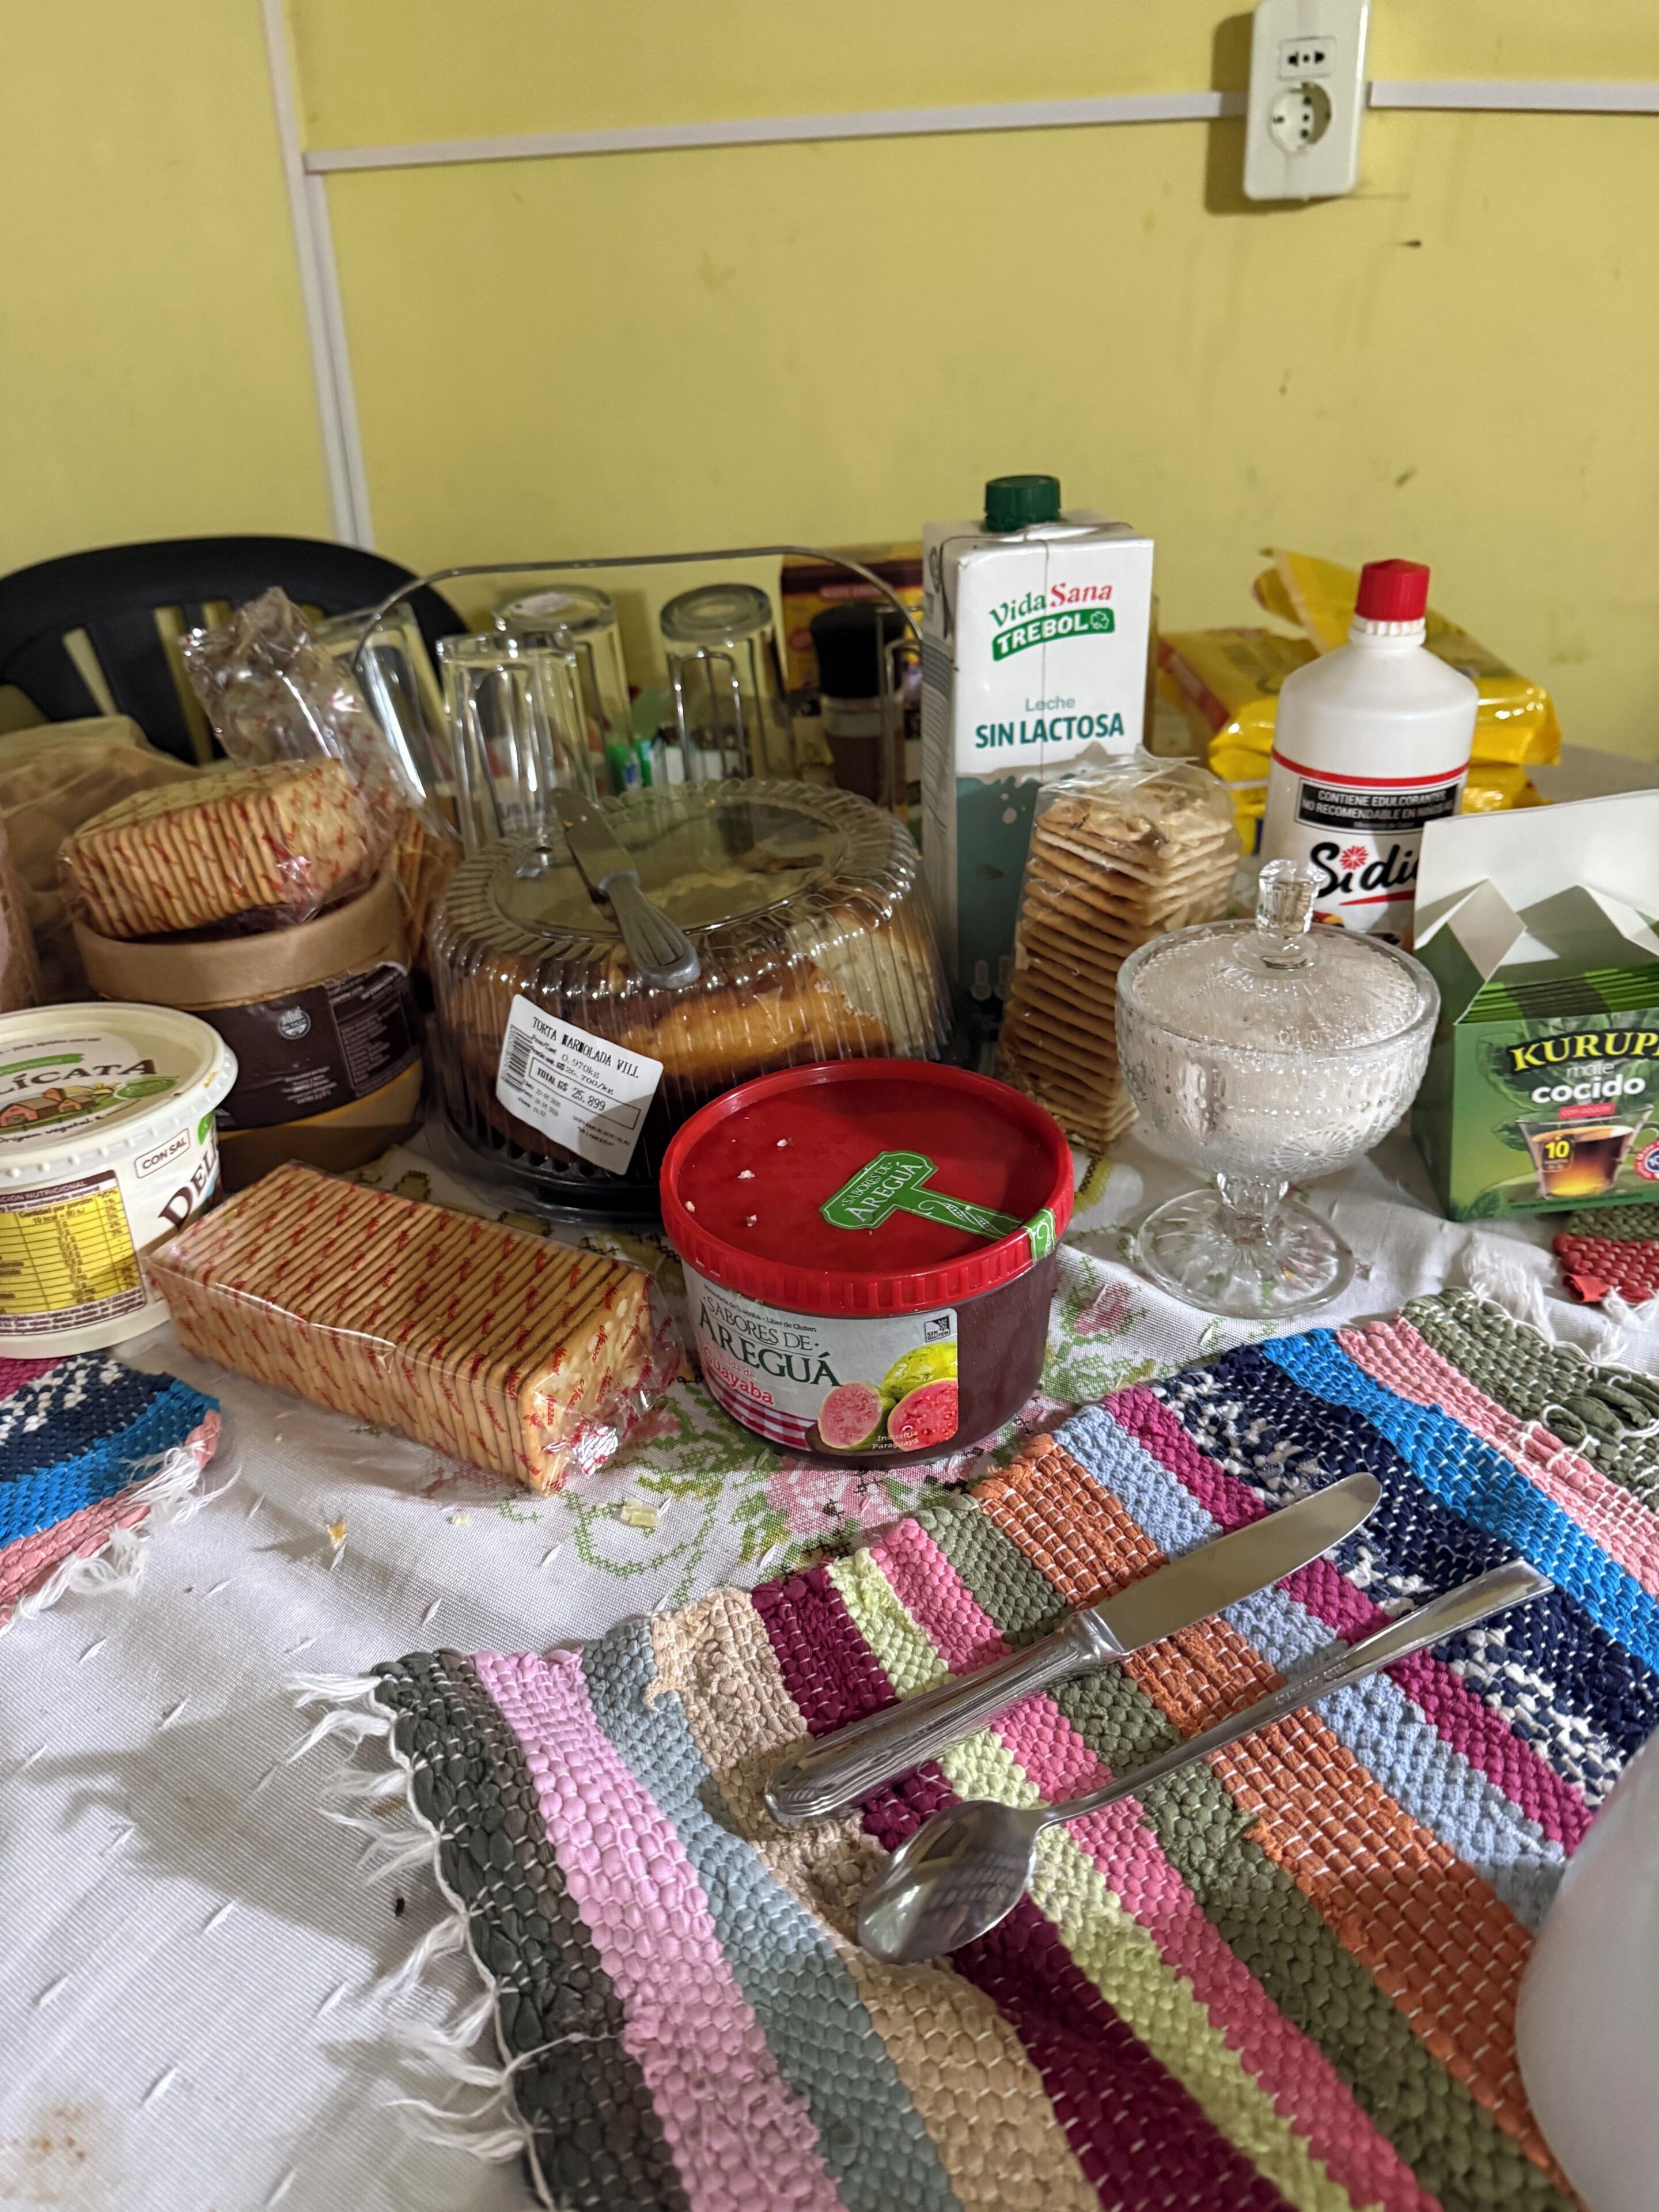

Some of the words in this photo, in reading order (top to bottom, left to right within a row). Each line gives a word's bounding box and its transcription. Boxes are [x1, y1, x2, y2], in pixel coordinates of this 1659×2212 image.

[989, 592, 1046, 628] Vida
[1050, 583, 1113, 608] Sana
[997, 613, 1088, 655] TREBOL
[1025, 696, 1075, 712] Leche
[975, 721, 1014, 749] SIN
[1020, 713, 1124, 744] LACTOSA
[1316, 801, 1400, 820] RECOMENDABLE
[1318, 790, 1369, 806] CONTIENE
[533, 1016, 557, 1041] TORTA
[616, 1058, 639, 1078] VILL
[537, 1067, 556, 1085] TOTAL
[1566, 1062, 1614, 1078] mate
[1532, 1074, 1646, 1104] cocido
[142, 1149, 168, 1169] CON
[169, 1138, 187, 1156] SAL
[1545, 1141, 1570, 1158] 10
[26, 1181, 88, 1200] NUTRICIONAL
[842, 1173, 882, 1205] SABORES
[874, 1164, 892, 1175] DE
[844, 1161, 923, 1222] AREGUÁ
[707, 1296, 779, 1346] SABORES
[783, 1331, 813, 1351] DE
[783, 1321, 793, 1329] de
[793, 1323, 817, 1332] Gluten
[699, 1301, 843, 1387] AREGUÁ
[703, 1346, 774, 1406] Guayaba
[872, 1438, 919, 1450] Paraguaya
[877, 1430, 919, 1442] Industria
